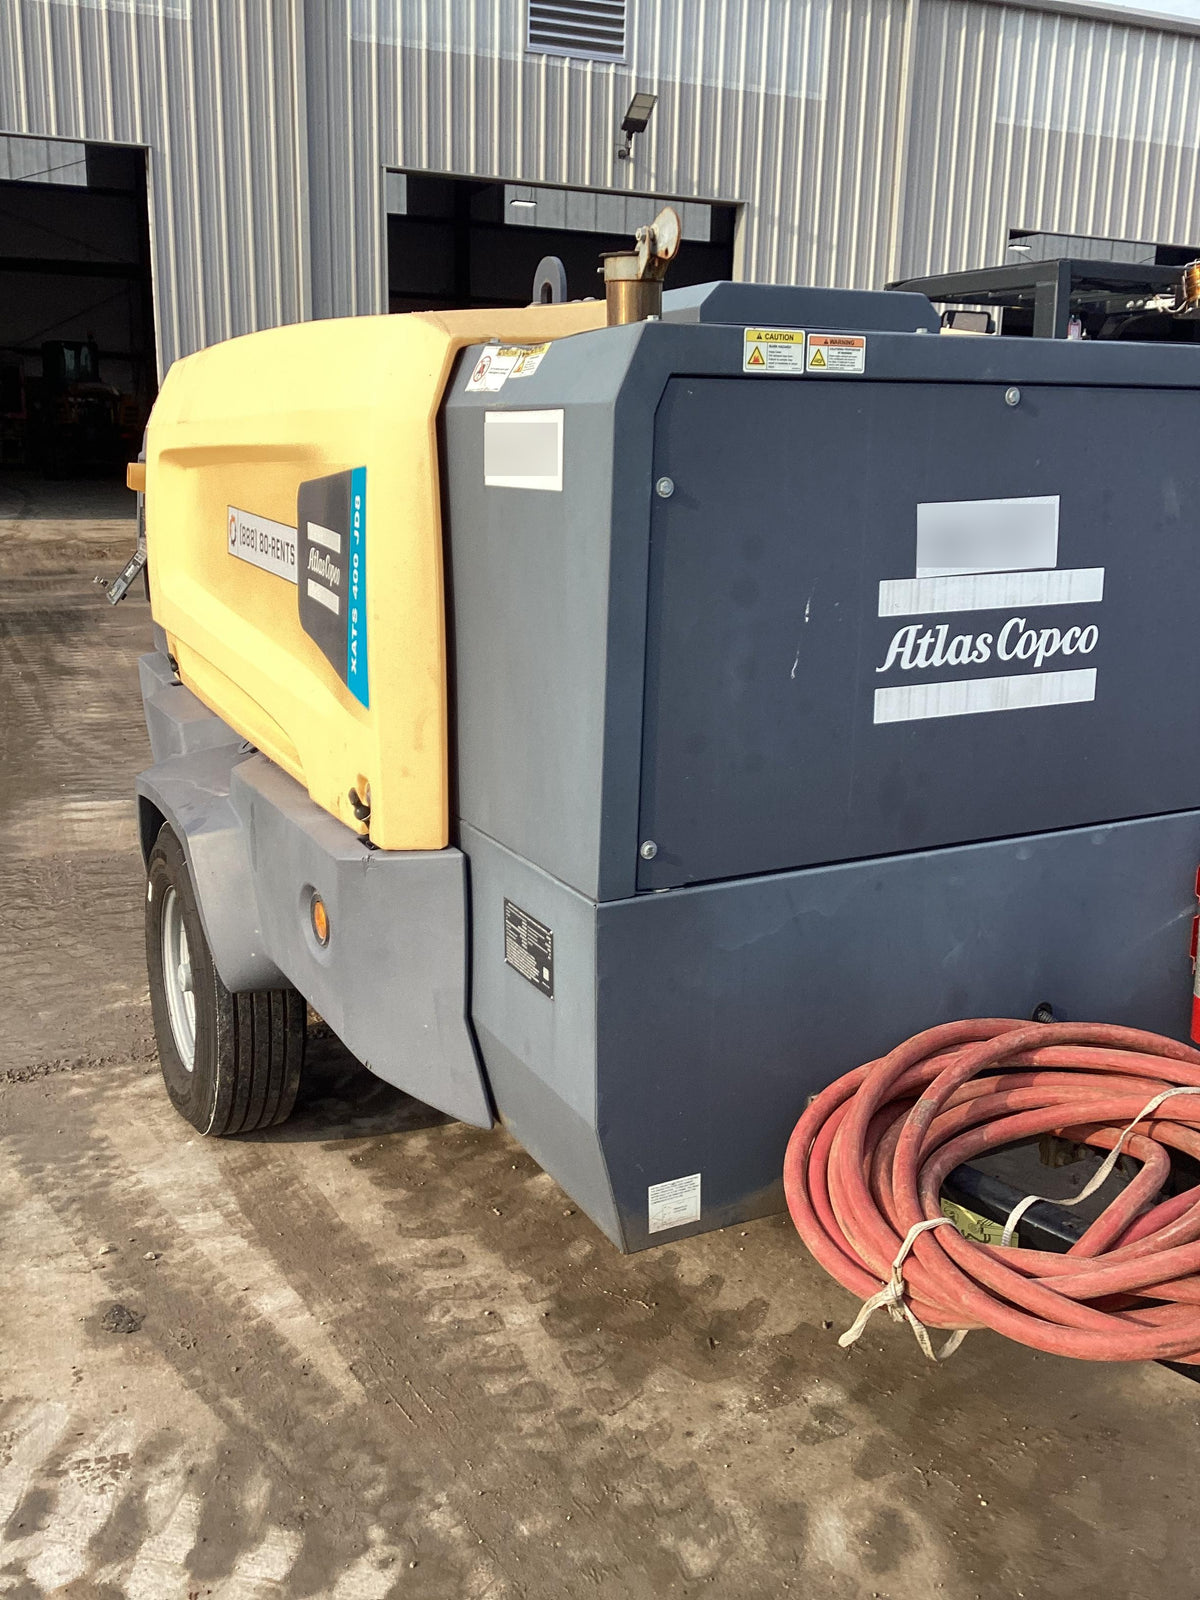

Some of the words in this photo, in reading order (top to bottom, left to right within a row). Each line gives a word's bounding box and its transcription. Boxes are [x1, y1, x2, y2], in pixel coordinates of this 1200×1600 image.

[764, 333, 795, 341] CAUTION
[239, 522, 257, 553] (888)
[259, 532, 295, 566] 80-RENTS
[307, 547, 325, 577] Atlas
[324, 552, 341, 587] Copco
[350, 608, 358, 675] XATS
[876, 623, 993, 673] Atlas
[997, 617, 1099, 668] Copco
